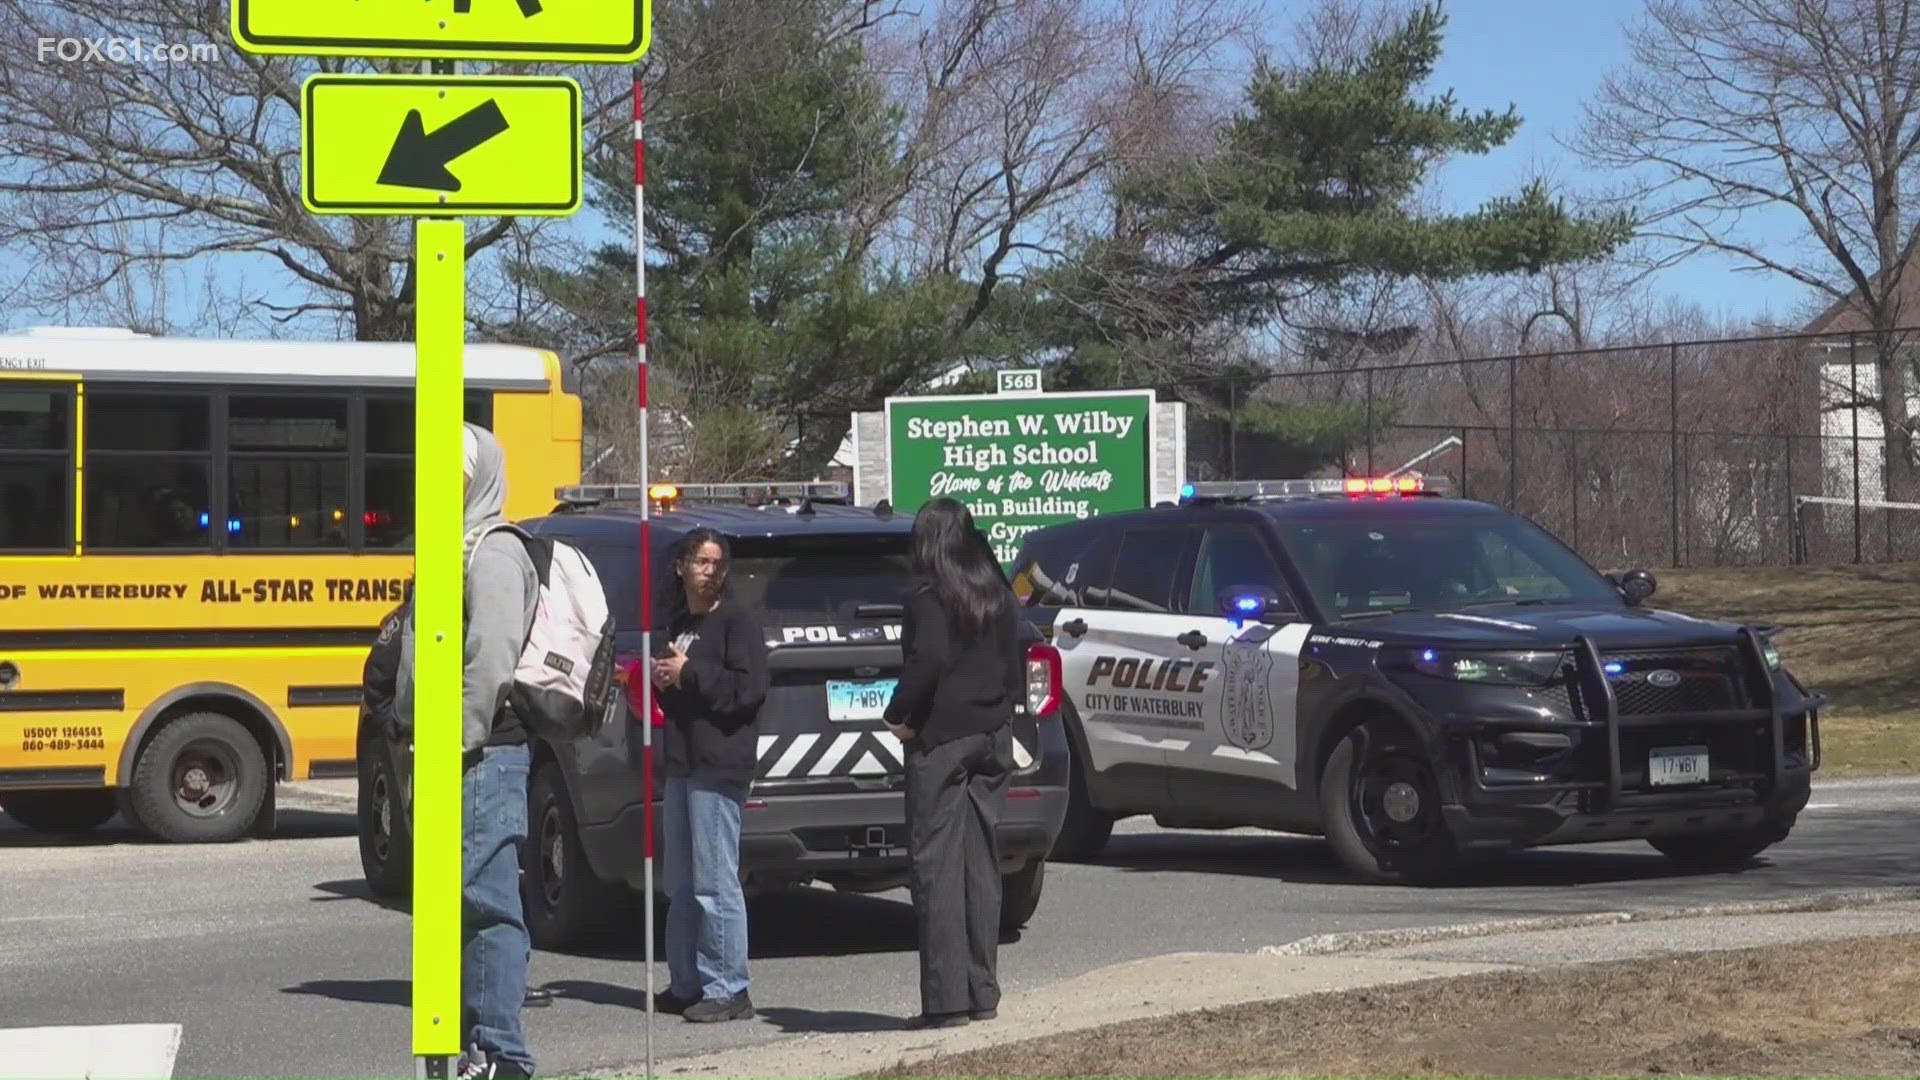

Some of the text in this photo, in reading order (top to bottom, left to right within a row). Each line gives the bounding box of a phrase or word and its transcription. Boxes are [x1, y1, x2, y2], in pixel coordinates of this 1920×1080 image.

[1004, 375, 1034, 389] 568
[907, 411, 1134, 443] Stephen W. Wilby
[943, 440, 1098, 472] High School
[929, 468, 1113, 496] Home of the Wildcats
[962, 498, 998, 517] ain
[1001, 496, 1090, 519] Building
[0, 584, 27, 600] OF
[38, 584, 188, 600] WATERBURY
[200, 578, 315, 602] ALL-STAR
[1086, 655, 1215, 693] POLICE
[1085, 693, 1205, 718] CITY OF WATERBURY
[23, 727, 58, 738] USDOT
[22, 739, 105, 752] 860-489-3444
